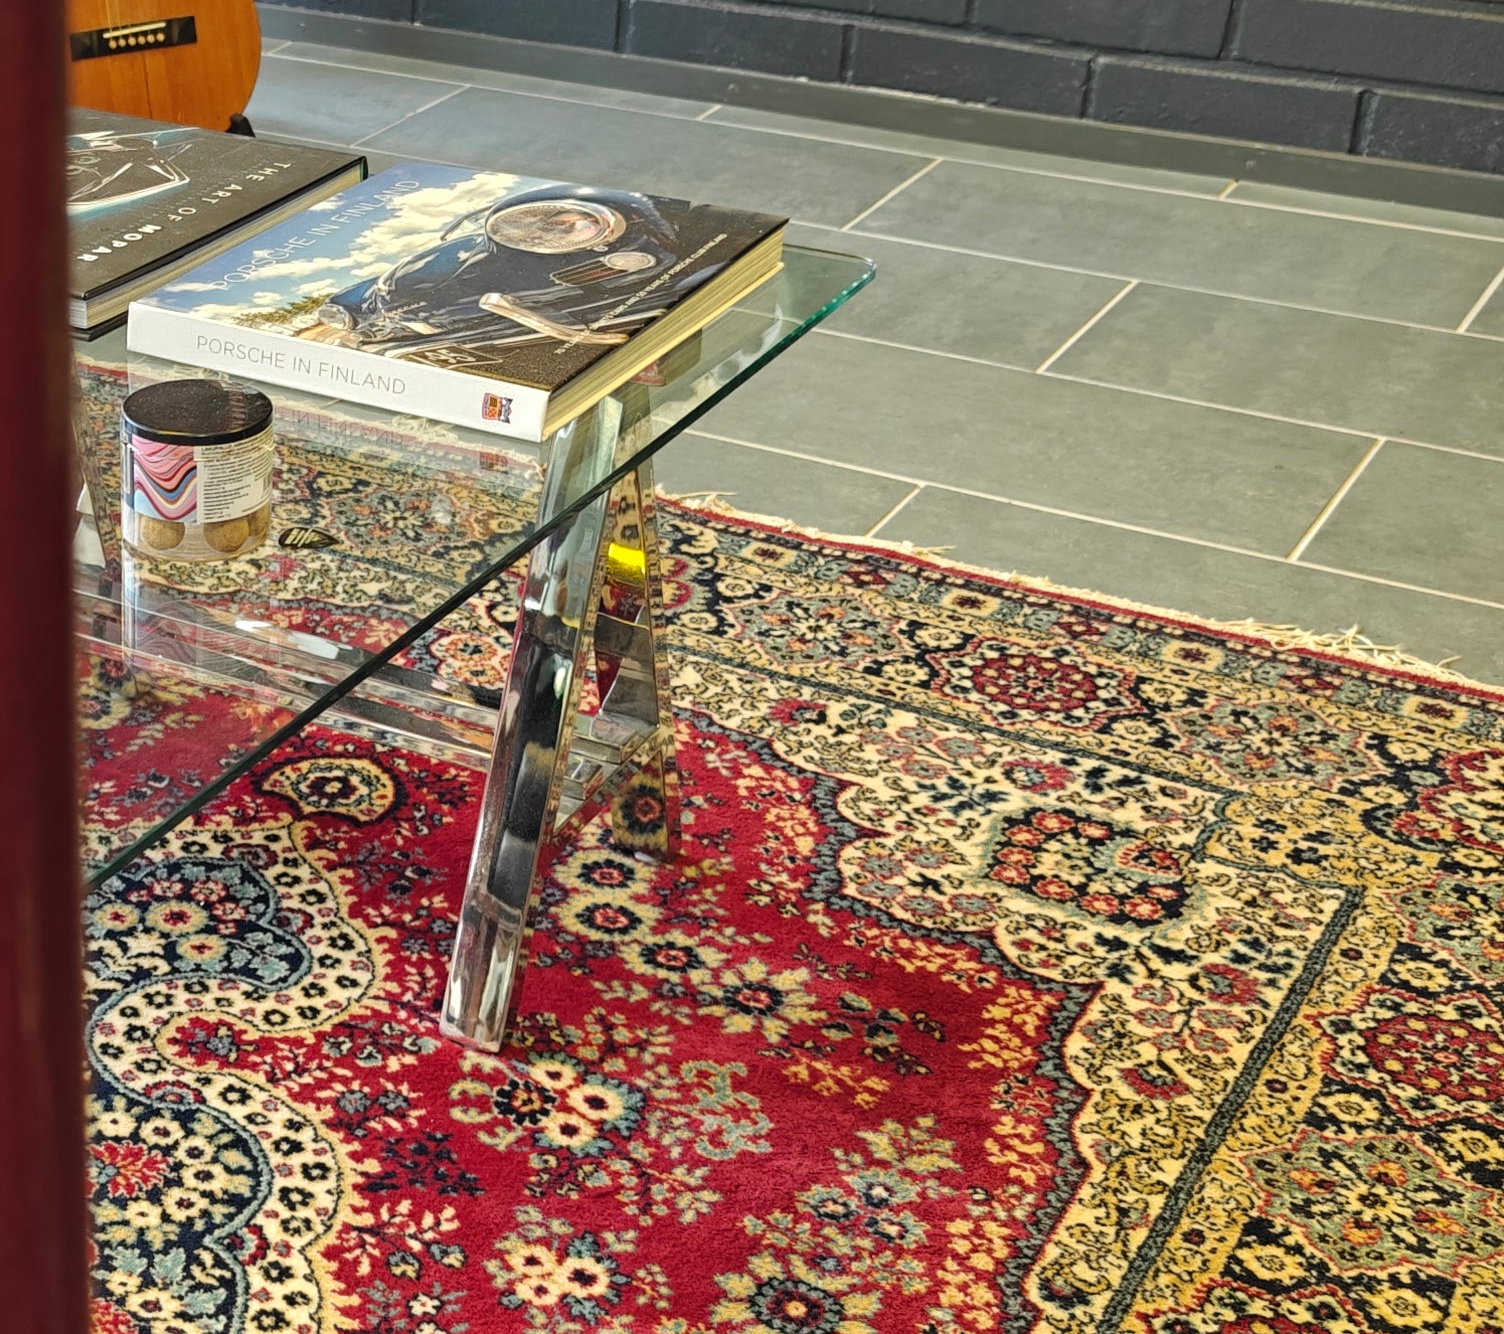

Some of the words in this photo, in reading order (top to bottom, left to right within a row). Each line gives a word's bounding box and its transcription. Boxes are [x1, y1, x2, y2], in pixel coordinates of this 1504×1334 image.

[246, 160, 291, 182] THE
[201, 183, 243, 205] ART
[167, 207, 196, 222] OF
[77, 224, 162, 262] MOPAR
[210, 236, 316, 291] PORSCHE
[306, 220, 341, 237] IN
[338, 180, 420, 224] FINLAND
[196, 335, 285, 369] PORSCHE
[292, 356, 311, 375] IN
[318, 362, 406, 395] FINLAND
